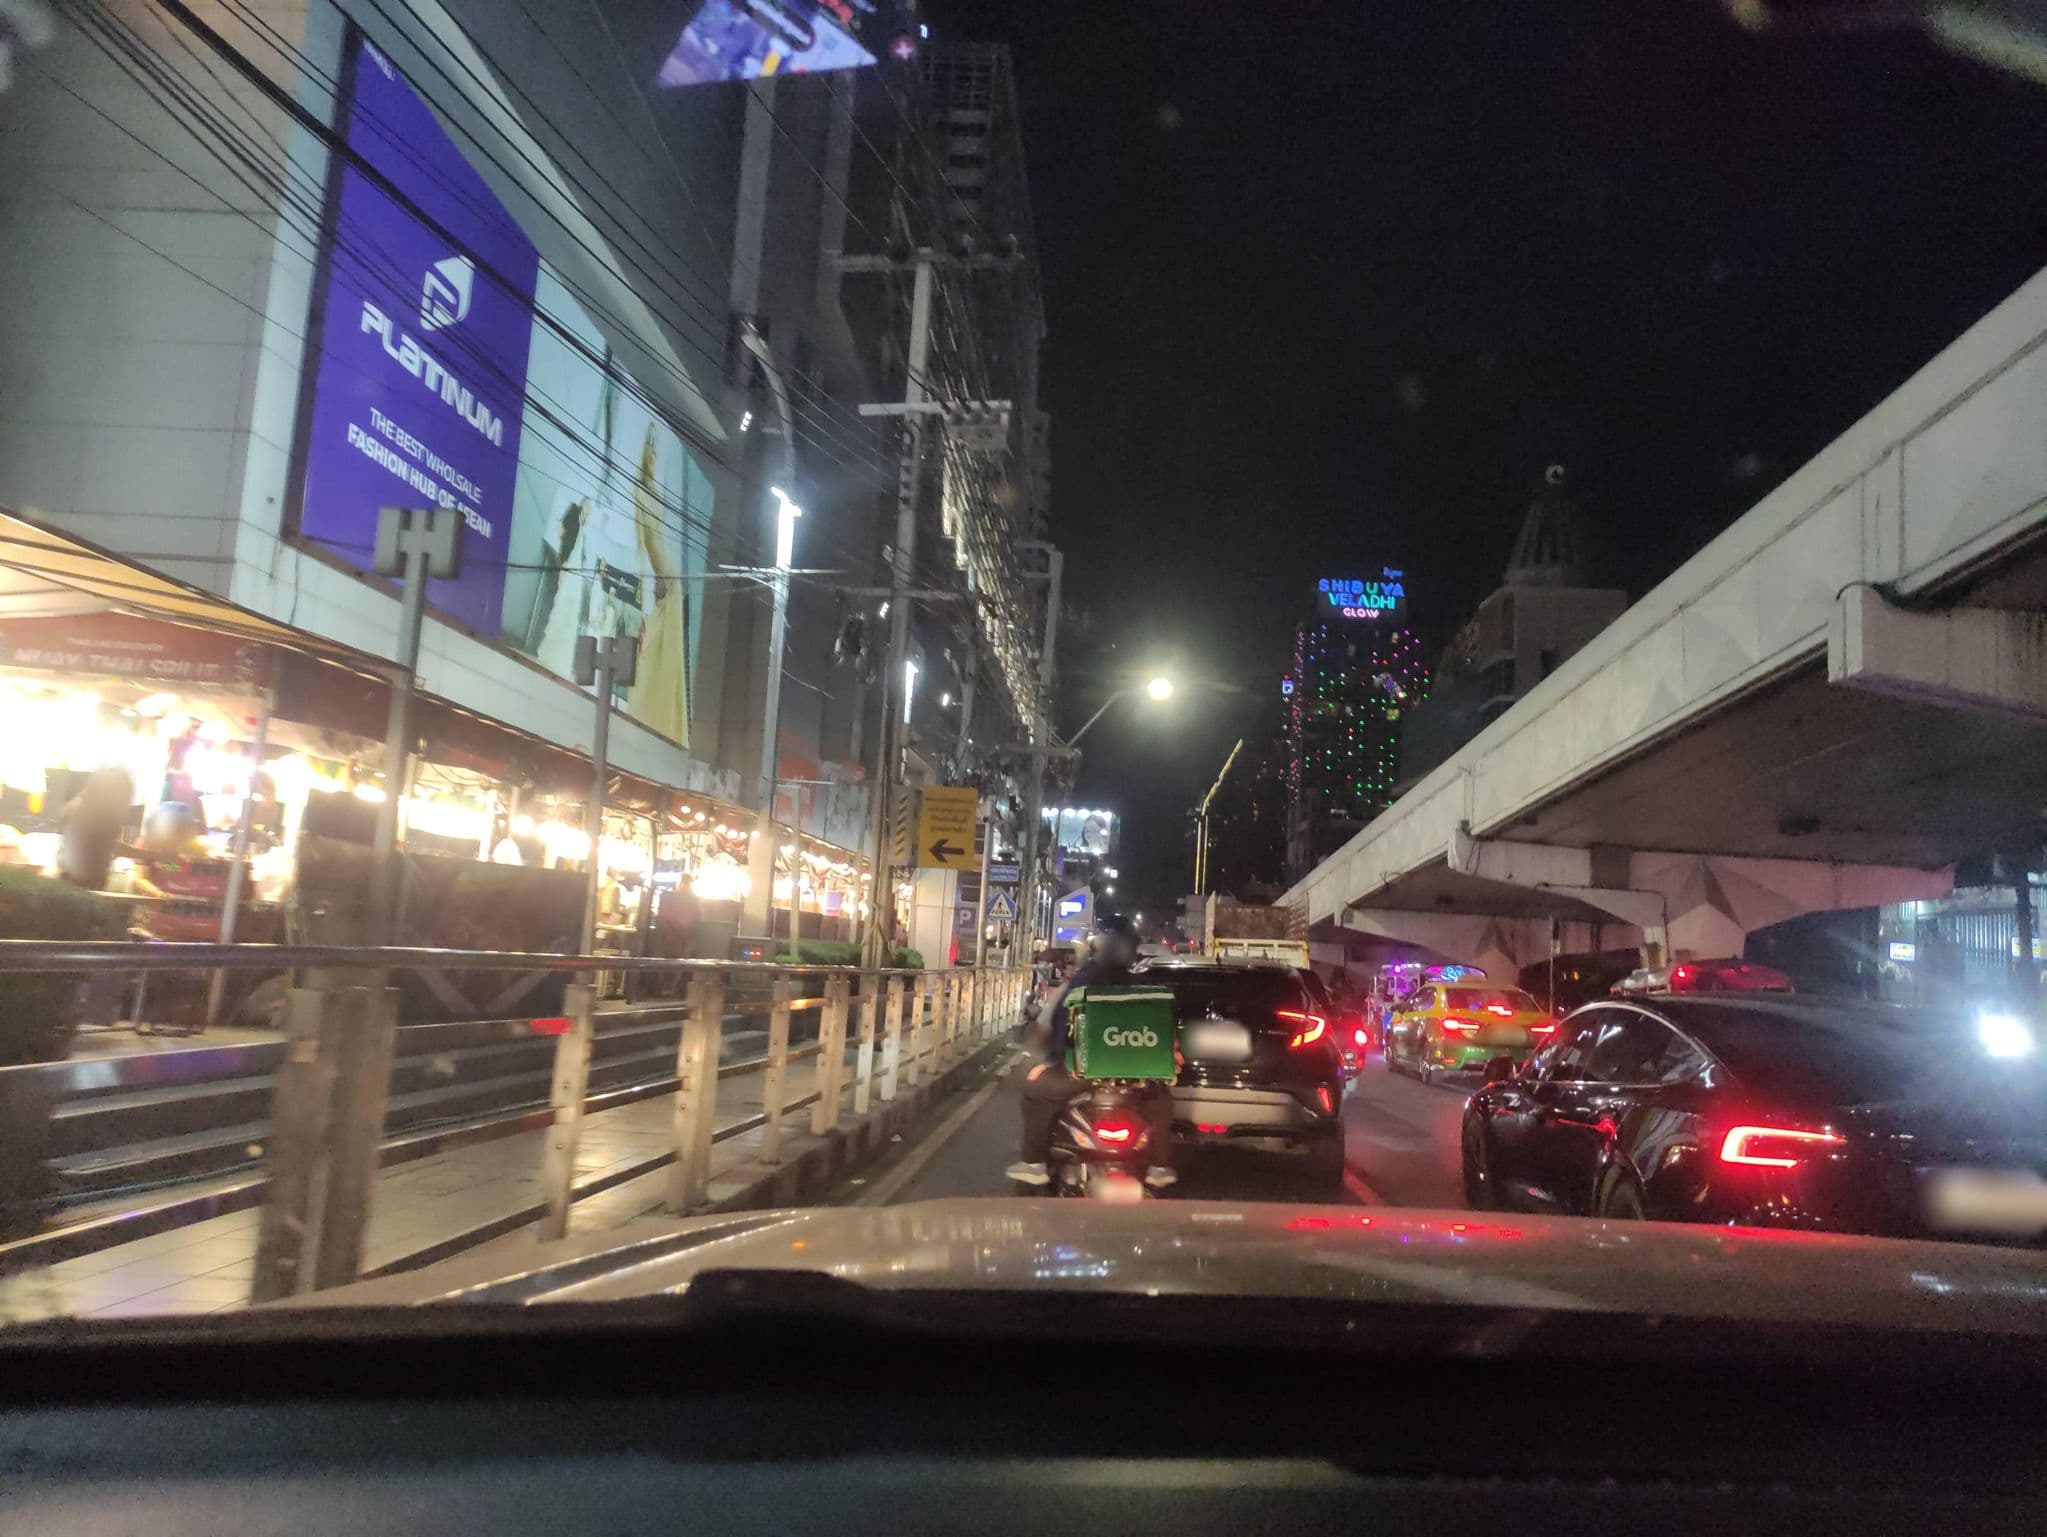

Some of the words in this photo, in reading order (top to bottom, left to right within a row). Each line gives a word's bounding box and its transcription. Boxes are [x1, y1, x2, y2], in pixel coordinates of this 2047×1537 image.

[370, 407, 397, 441] THE
[396, 427, 427, 460] BEST
[348, 423, 408, 481] FASHION
[410, 467, 438, 500] HUB
[438, 489, 457, 509] OF
[1319, 578, 1404, 597] SHIBUYA
[1343, 607, 1379, 618] GLOW
[959, 909, 972, 925] P
[1103, 1026, 1158, 1047] Grab
